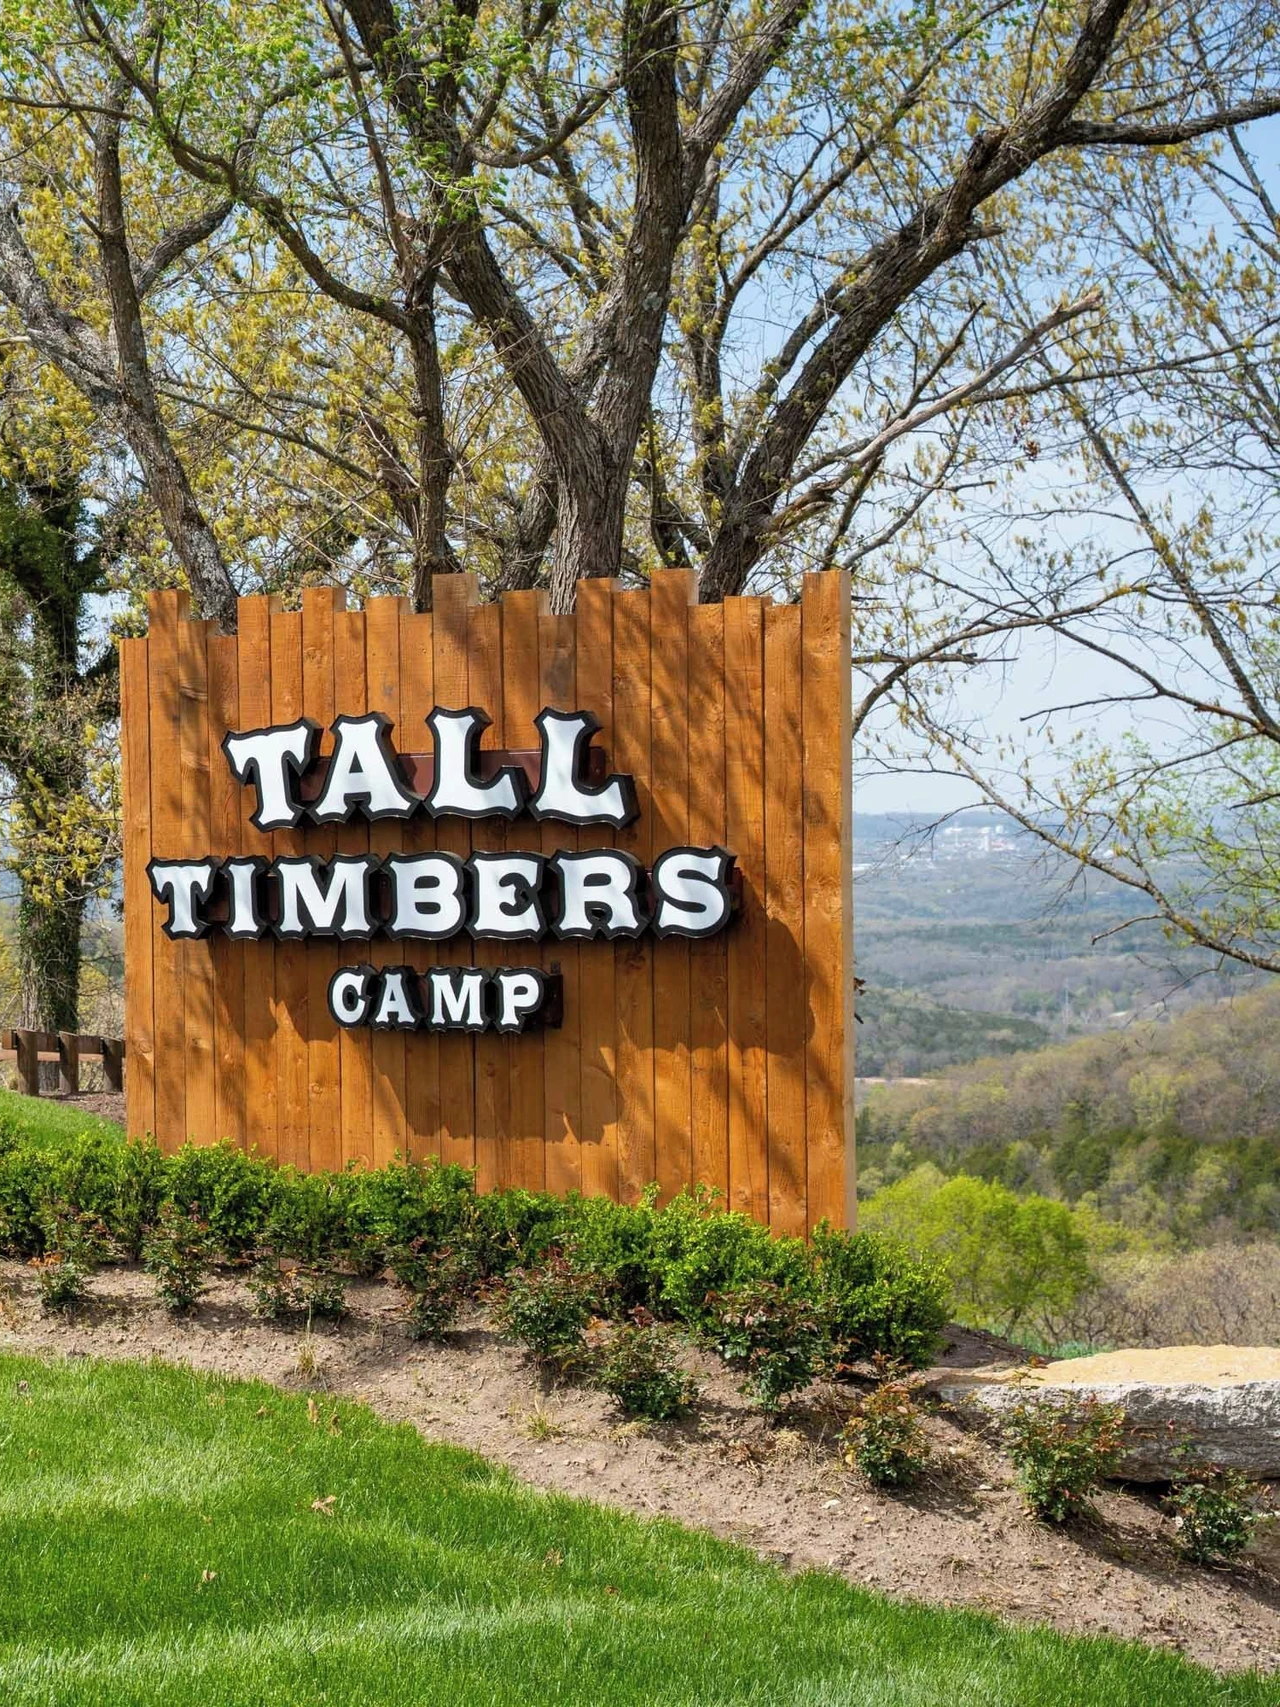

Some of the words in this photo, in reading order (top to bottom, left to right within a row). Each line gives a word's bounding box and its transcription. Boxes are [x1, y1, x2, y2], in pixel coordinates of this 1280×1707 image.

[222, 706, 640, 832] TALL
[147, 846, 734, 941] TIMBERS
[329, 964, 543, 1032] CAMP
